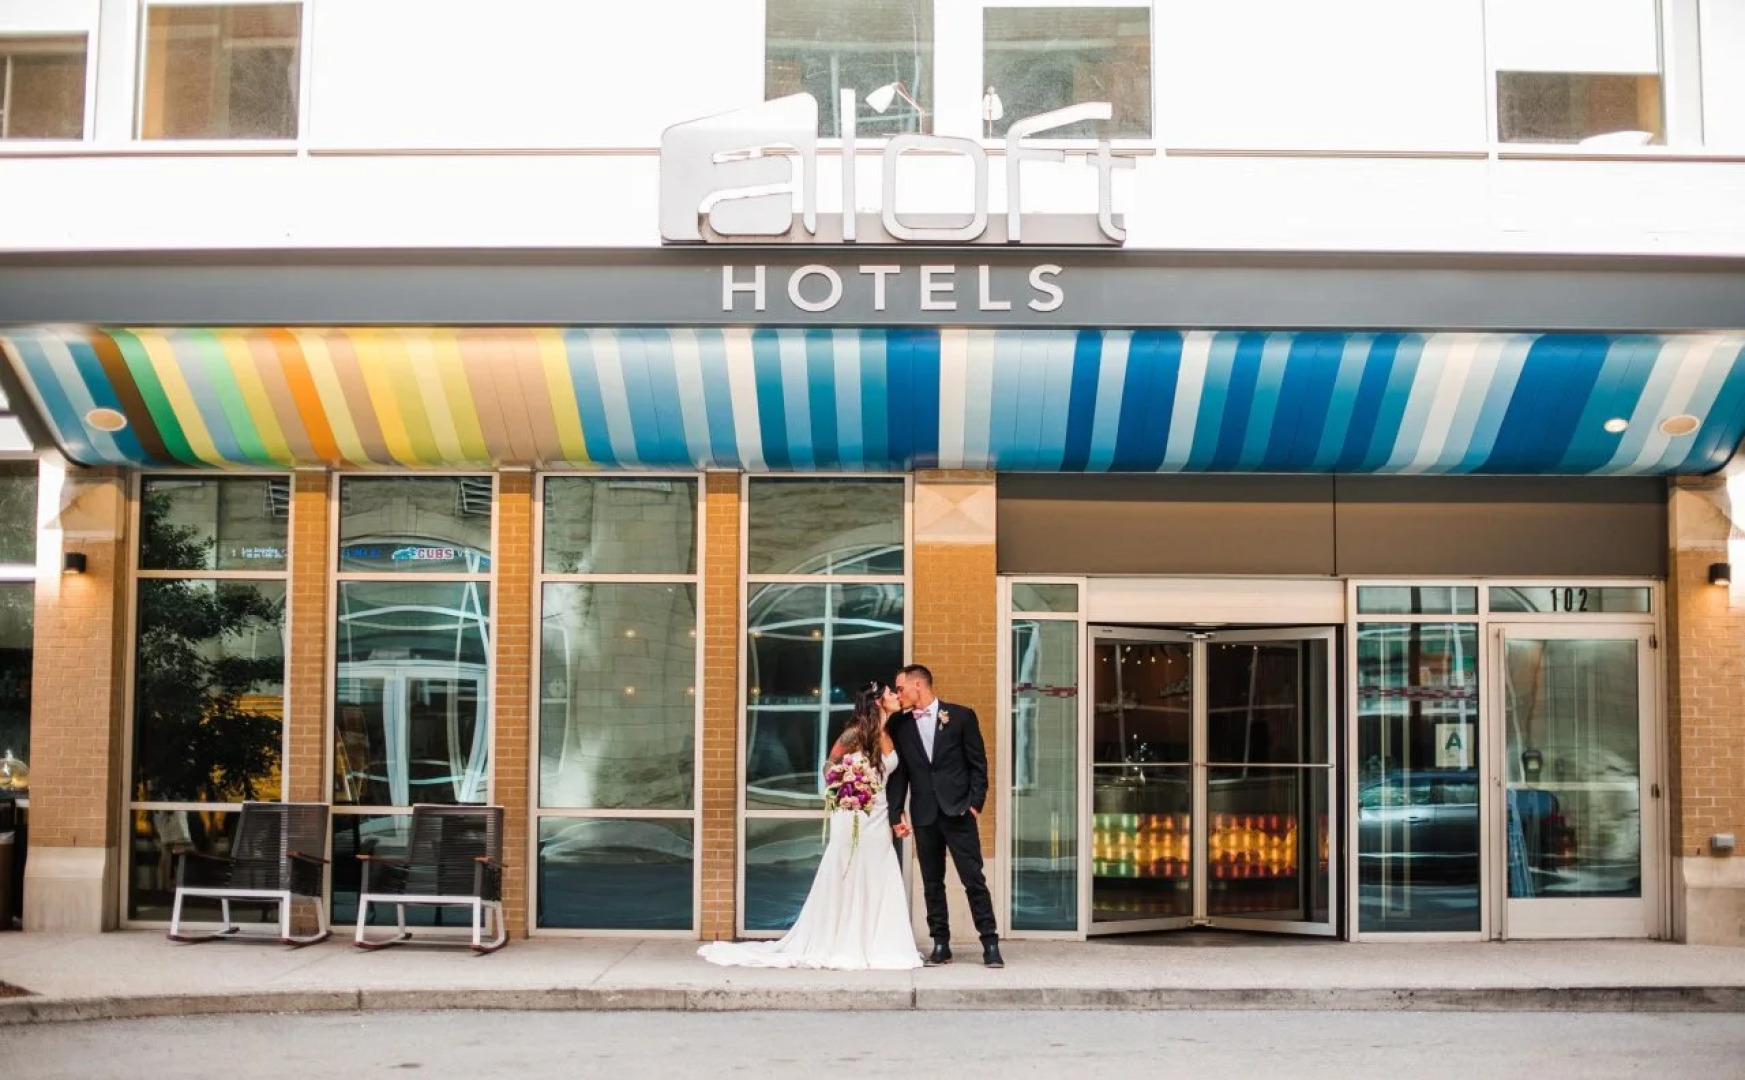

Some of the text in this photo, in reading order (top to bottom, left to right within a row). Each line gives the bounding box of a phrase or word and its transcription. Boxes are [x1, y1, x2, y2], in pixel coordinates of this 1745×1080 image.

[661, 88, 1136, 245] aloft
[721, 264, 1065, 312] HOTELS
[417, 549, 452, 559] CUBS
[1551, 588, 1589, 612] 102
[1445, 731, 1462, 750] A
